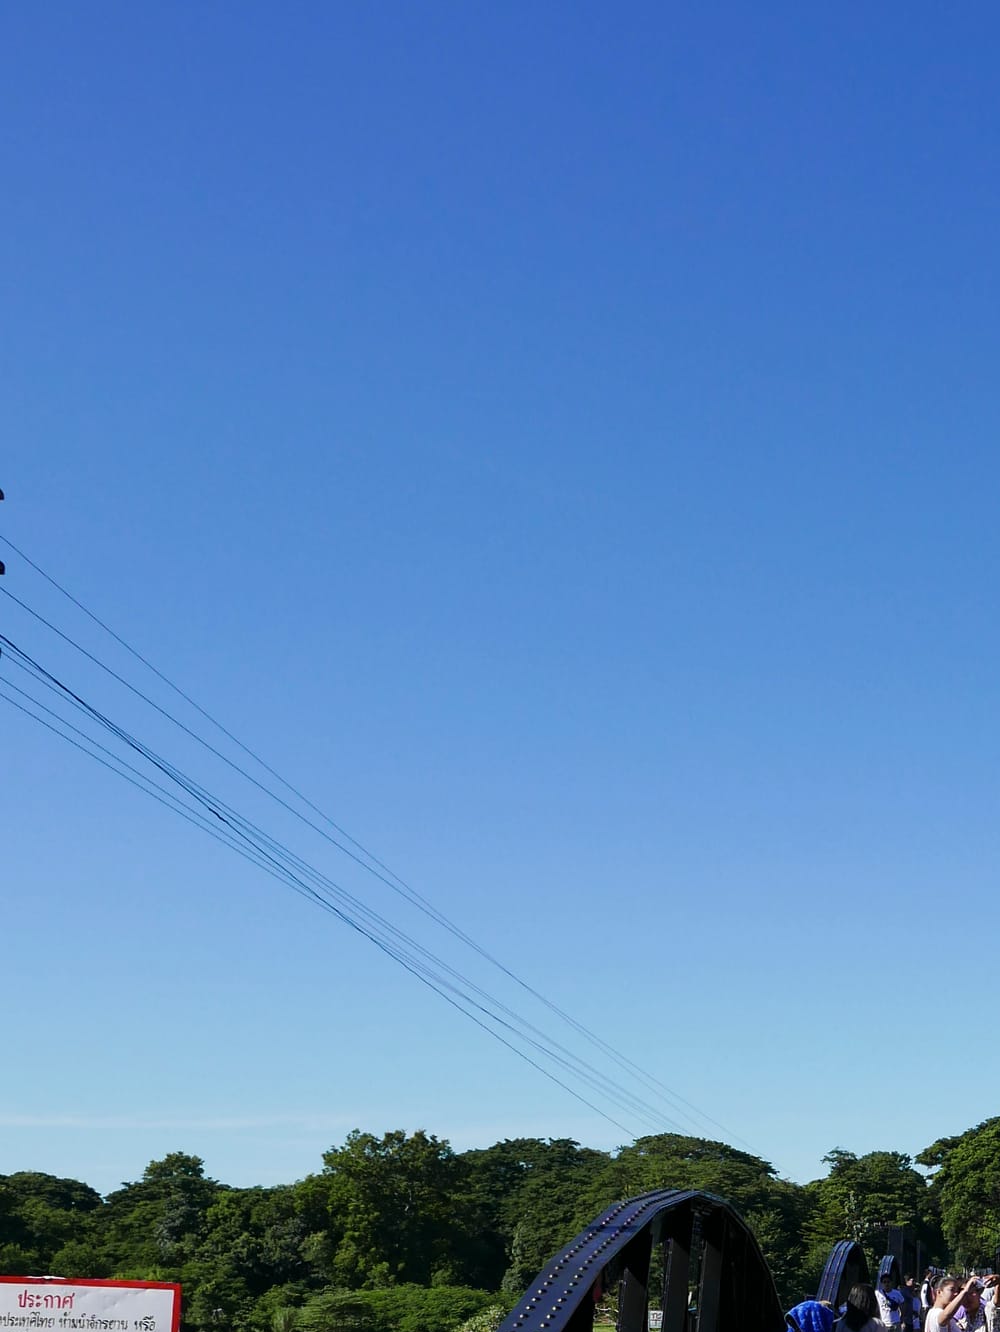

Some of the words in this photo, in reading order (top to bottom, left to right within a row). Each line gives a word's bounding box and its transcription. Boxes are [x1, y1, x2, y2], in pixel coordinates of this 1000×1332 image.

[18, 1289, 75, 1309] ประกาศ
[134, 1315, 156, 1332] หรือ
